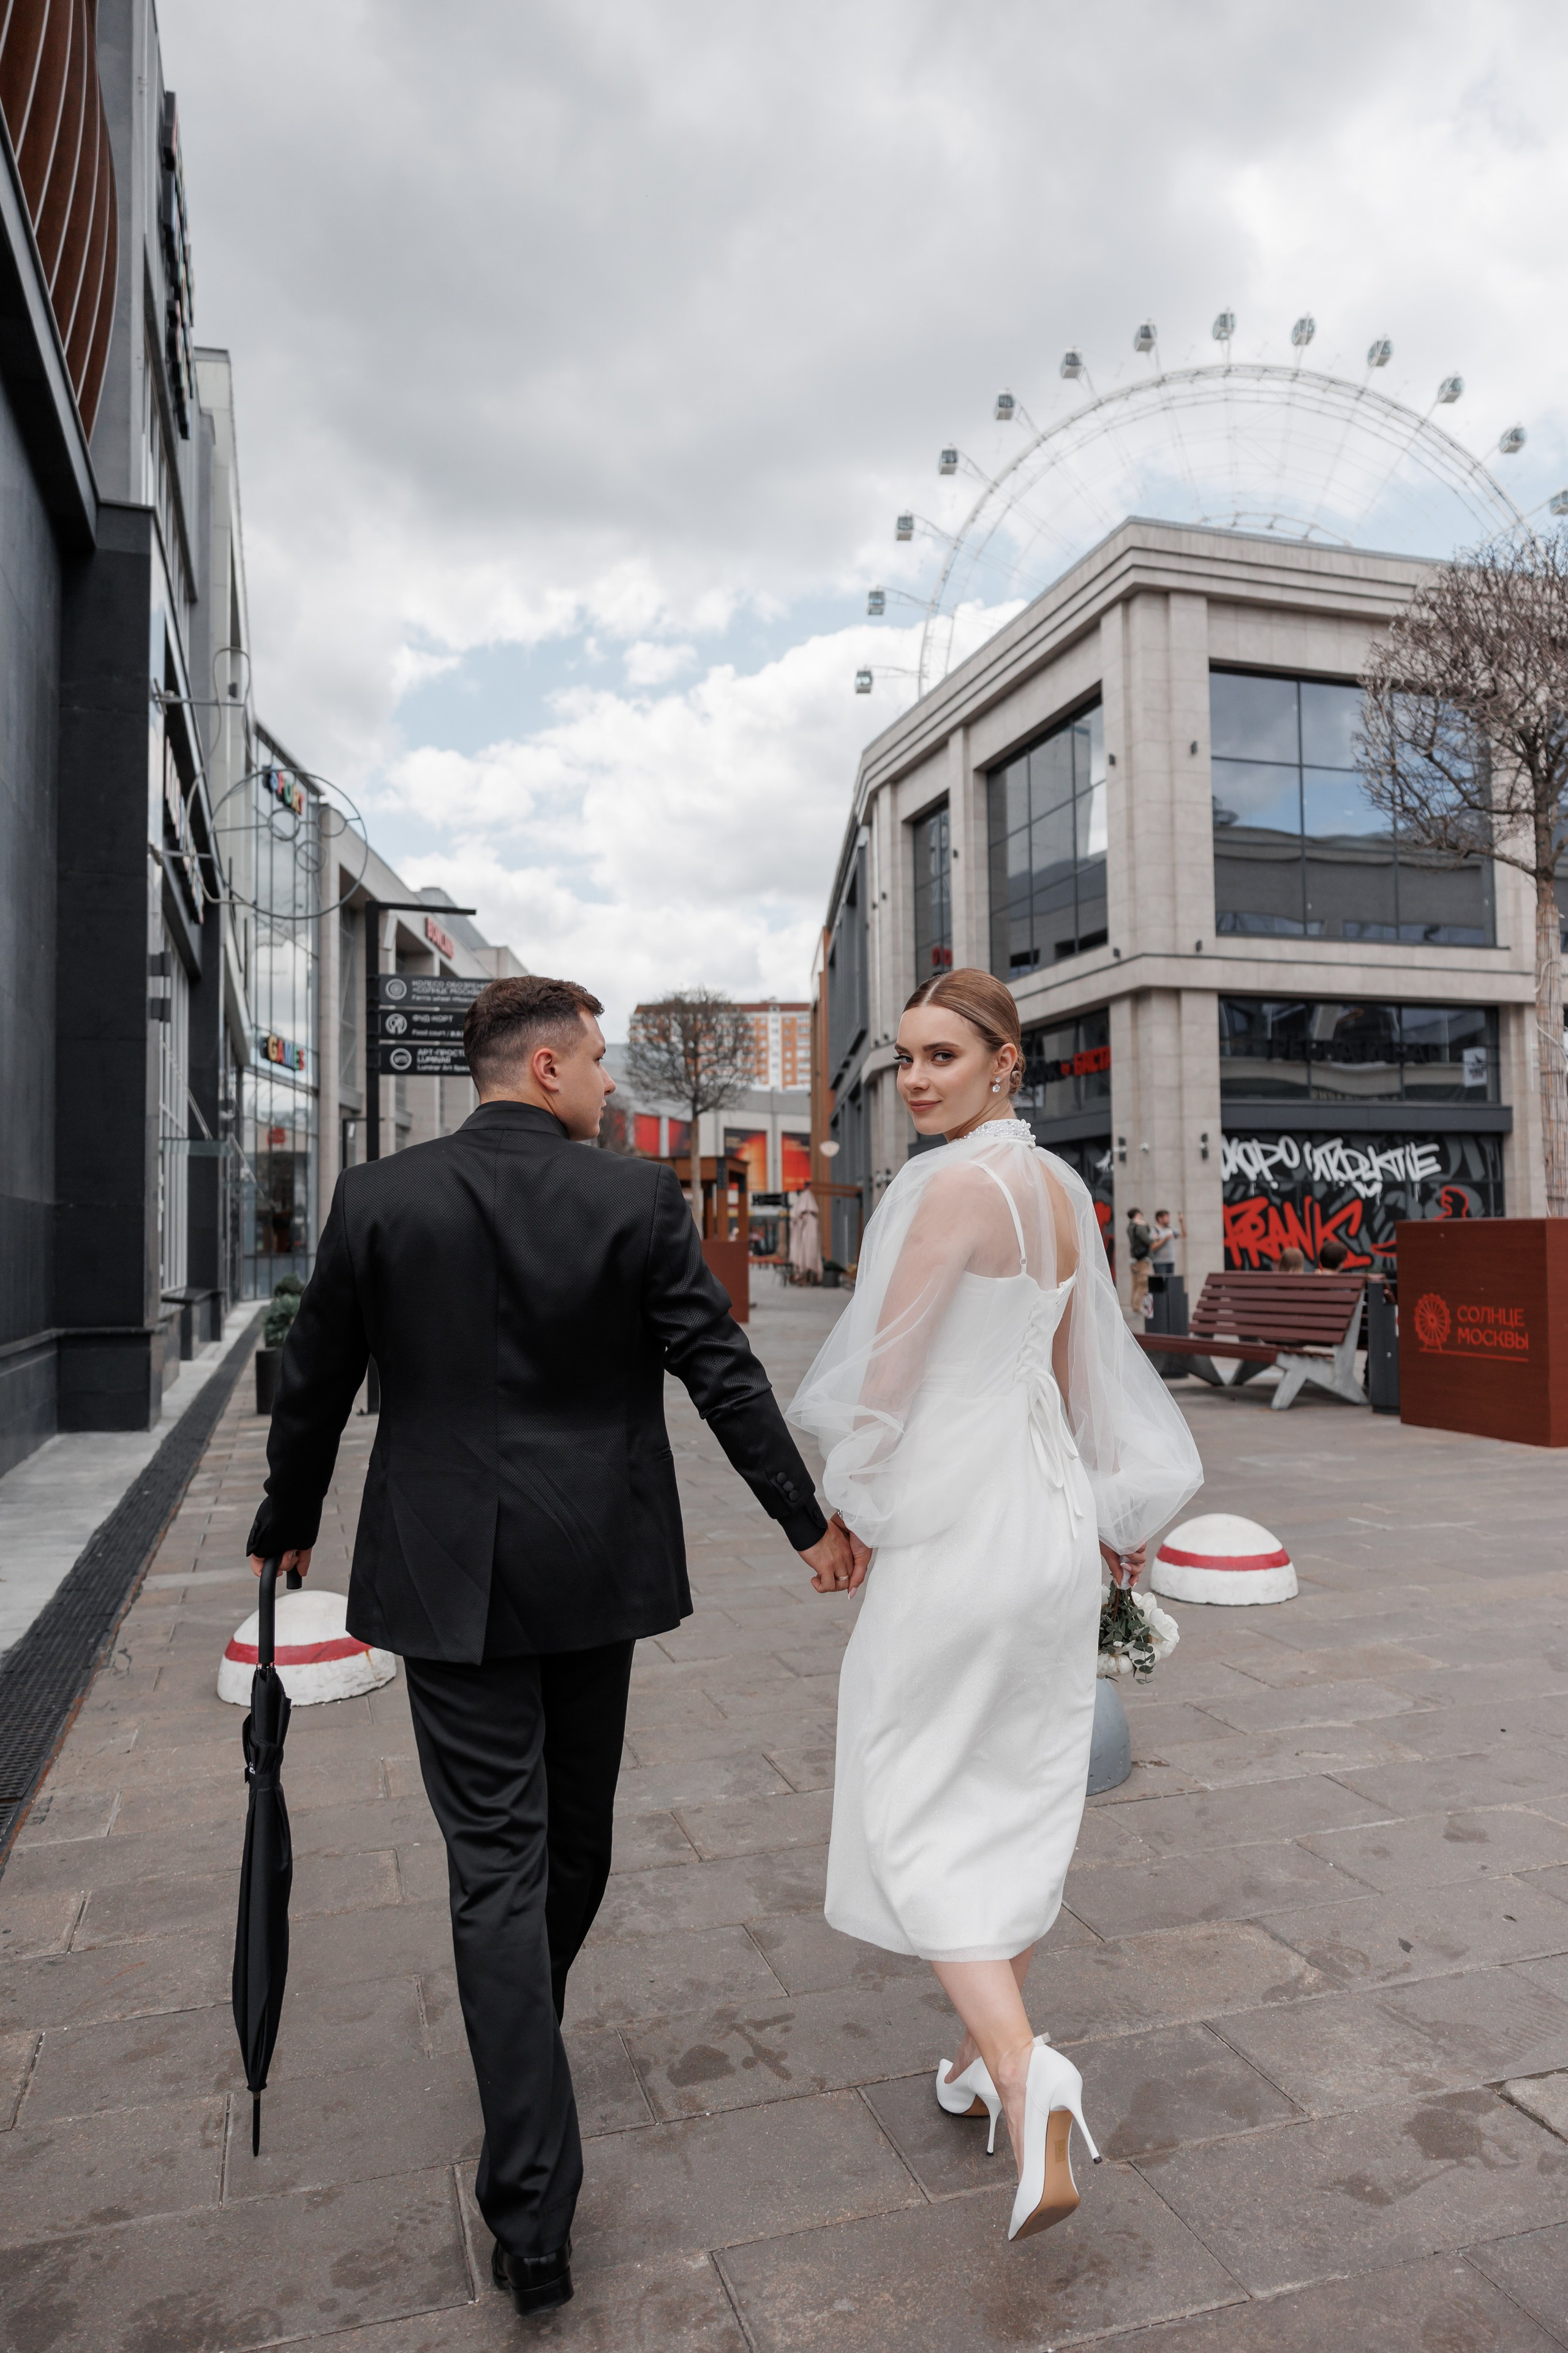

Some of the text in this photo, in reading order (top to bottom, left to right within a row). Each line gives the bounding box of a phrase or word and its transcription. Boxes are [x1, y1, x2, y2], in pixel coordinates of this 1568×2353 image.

[269, 764, 305, 817] SPORT
[267, 1034, 305, 1071] GAMES
[1223, 1196, 1371, 1270] FRANK
[1457, 1305, 1525, 1329] СОЛНЦЕ
[1458, 1327, 1529, 1350] МОСКВЫ
